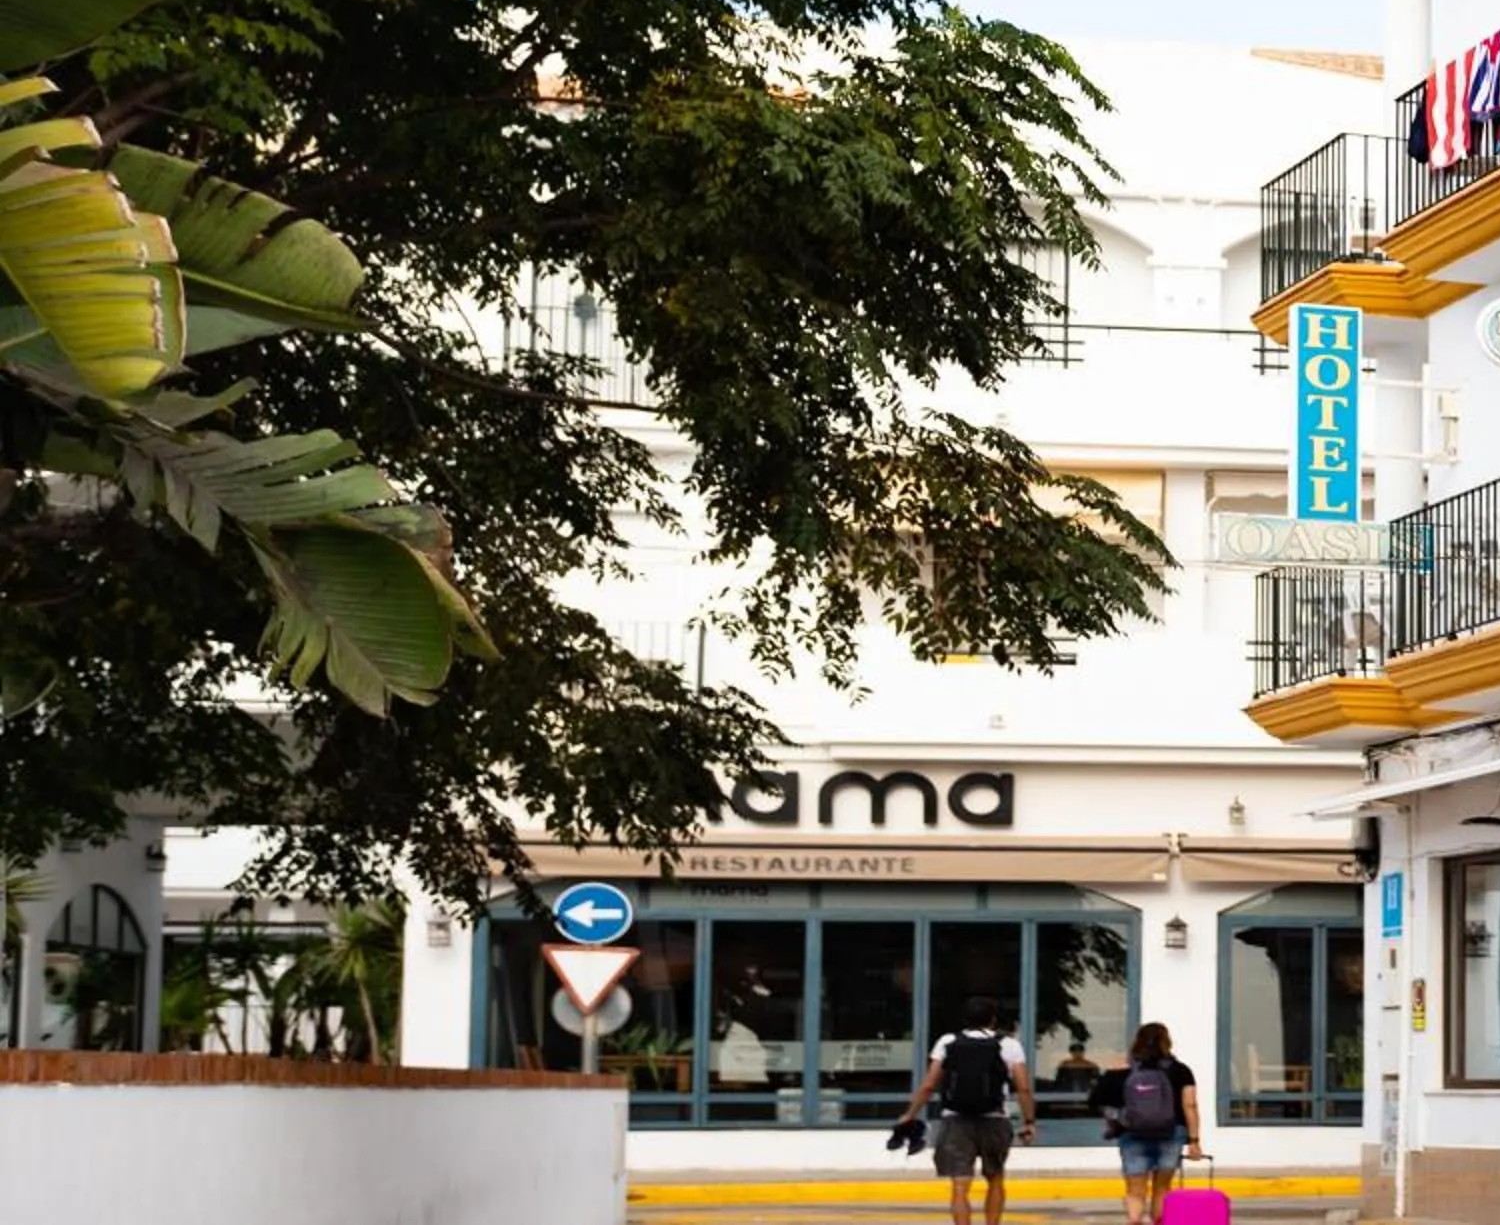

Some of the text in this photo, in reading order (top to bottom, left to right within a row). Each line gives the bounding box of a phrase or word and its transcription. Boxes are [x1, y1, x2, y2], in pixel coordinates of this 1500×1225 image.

[1303, 312, 1350, 514] HOTEL
[690, 770, 1015, 827] ama
[689, 855, 916, 873] RESTAURANTE
